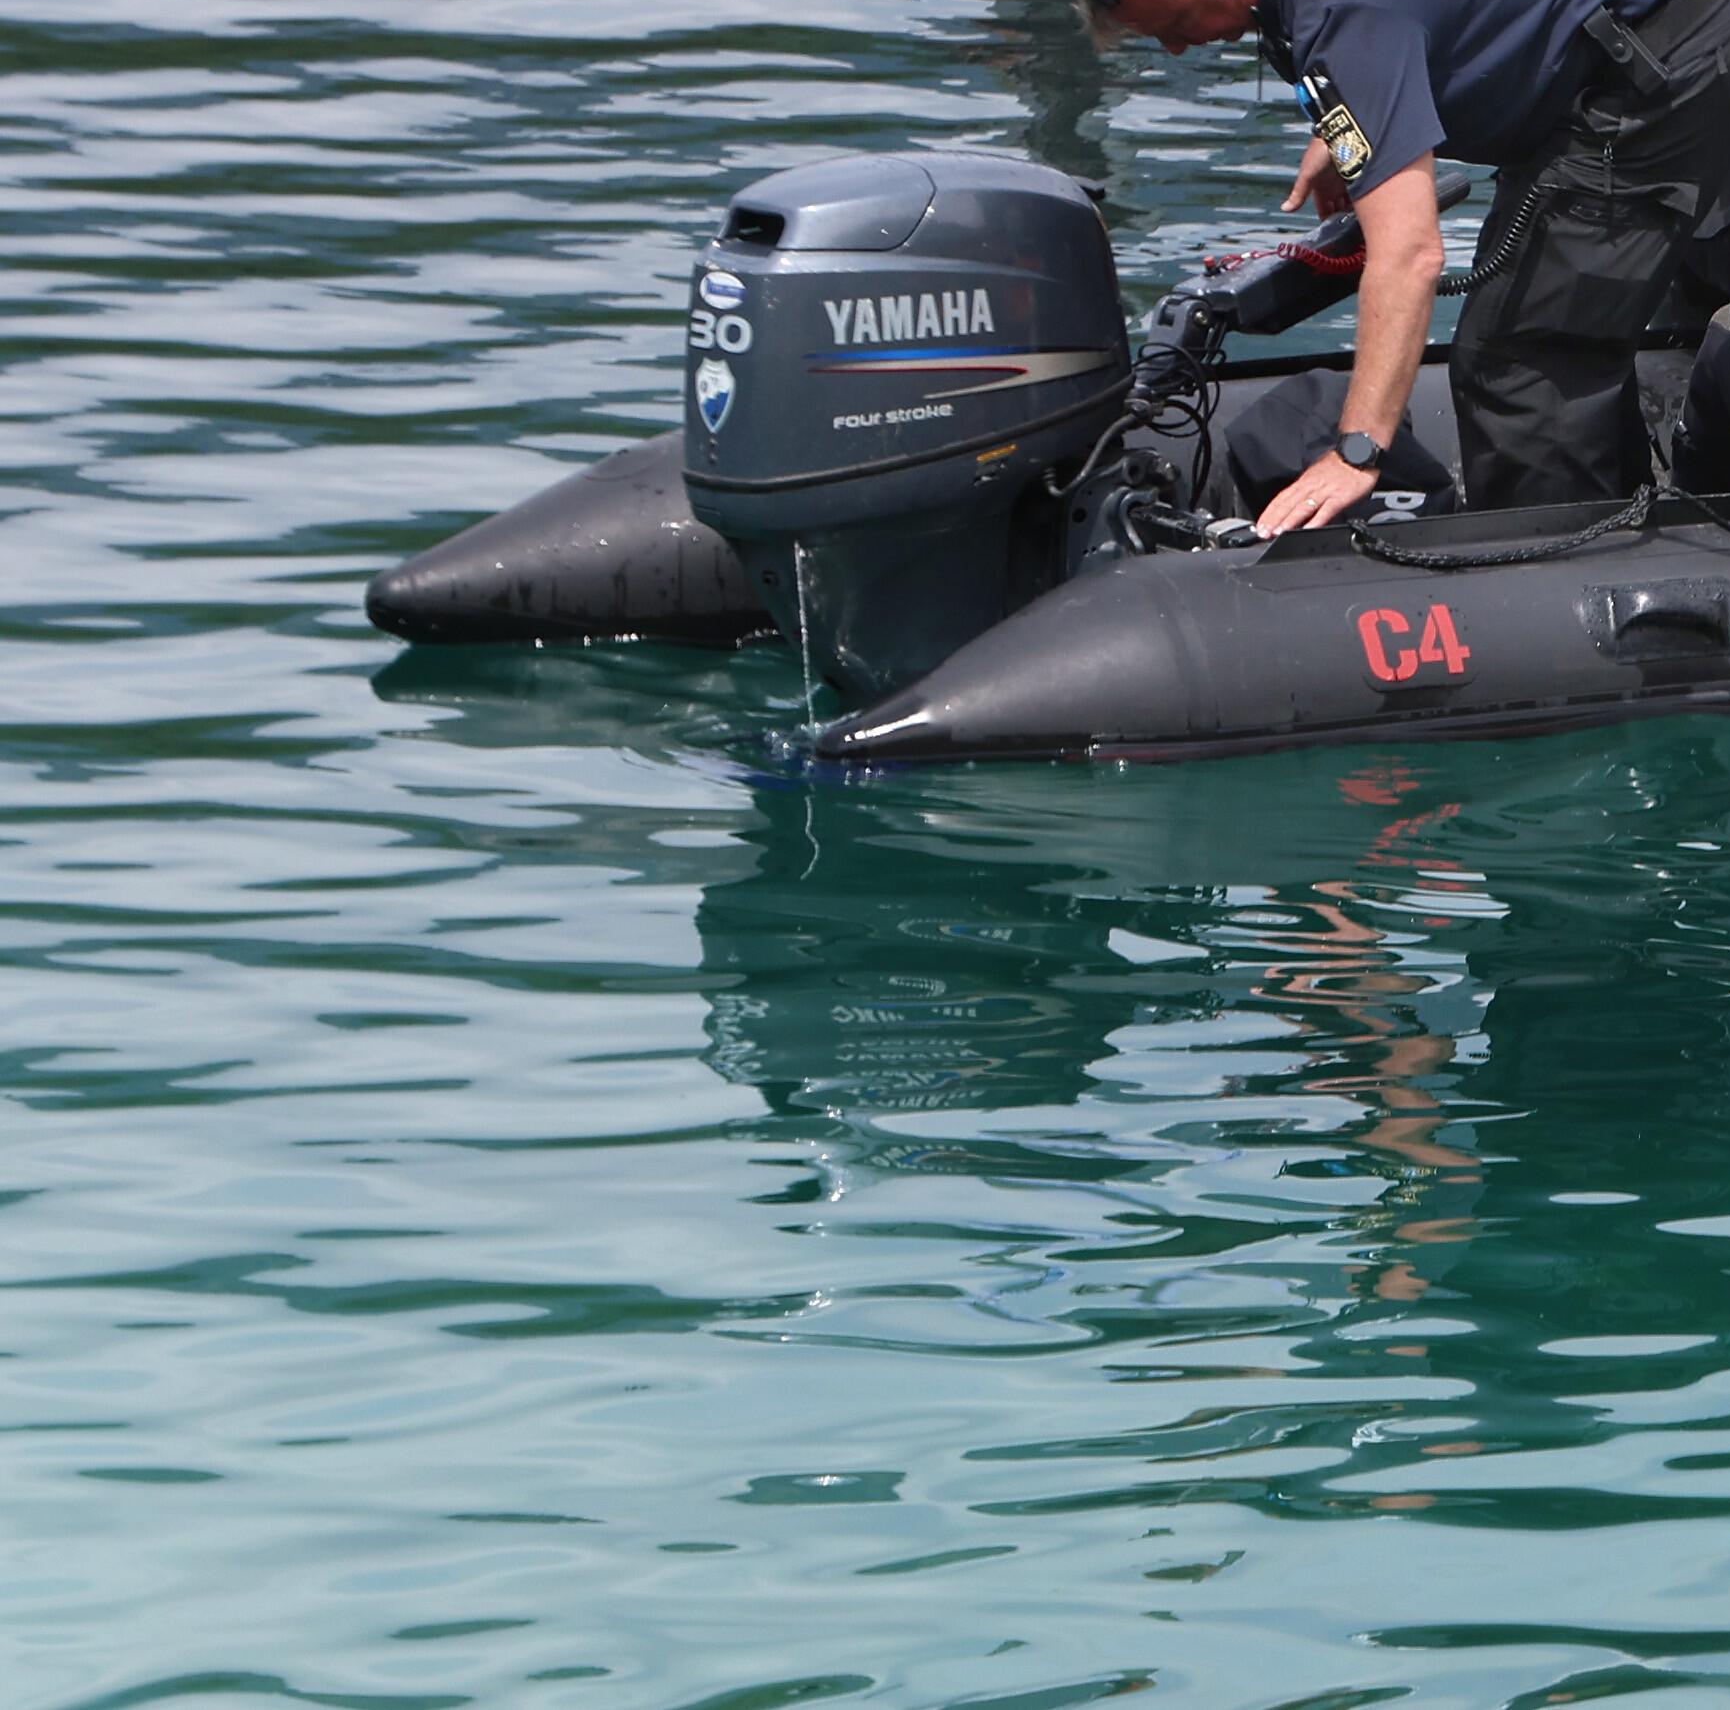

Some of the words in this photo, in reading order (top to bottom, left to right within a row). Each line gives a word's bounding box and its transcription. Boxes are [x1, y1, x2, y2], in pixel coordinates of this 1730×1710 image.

[690, 309, 752, 354] 30
[824, 289, 995, 345] YAMAHA
[1357, 603, 1471, 681] C4
